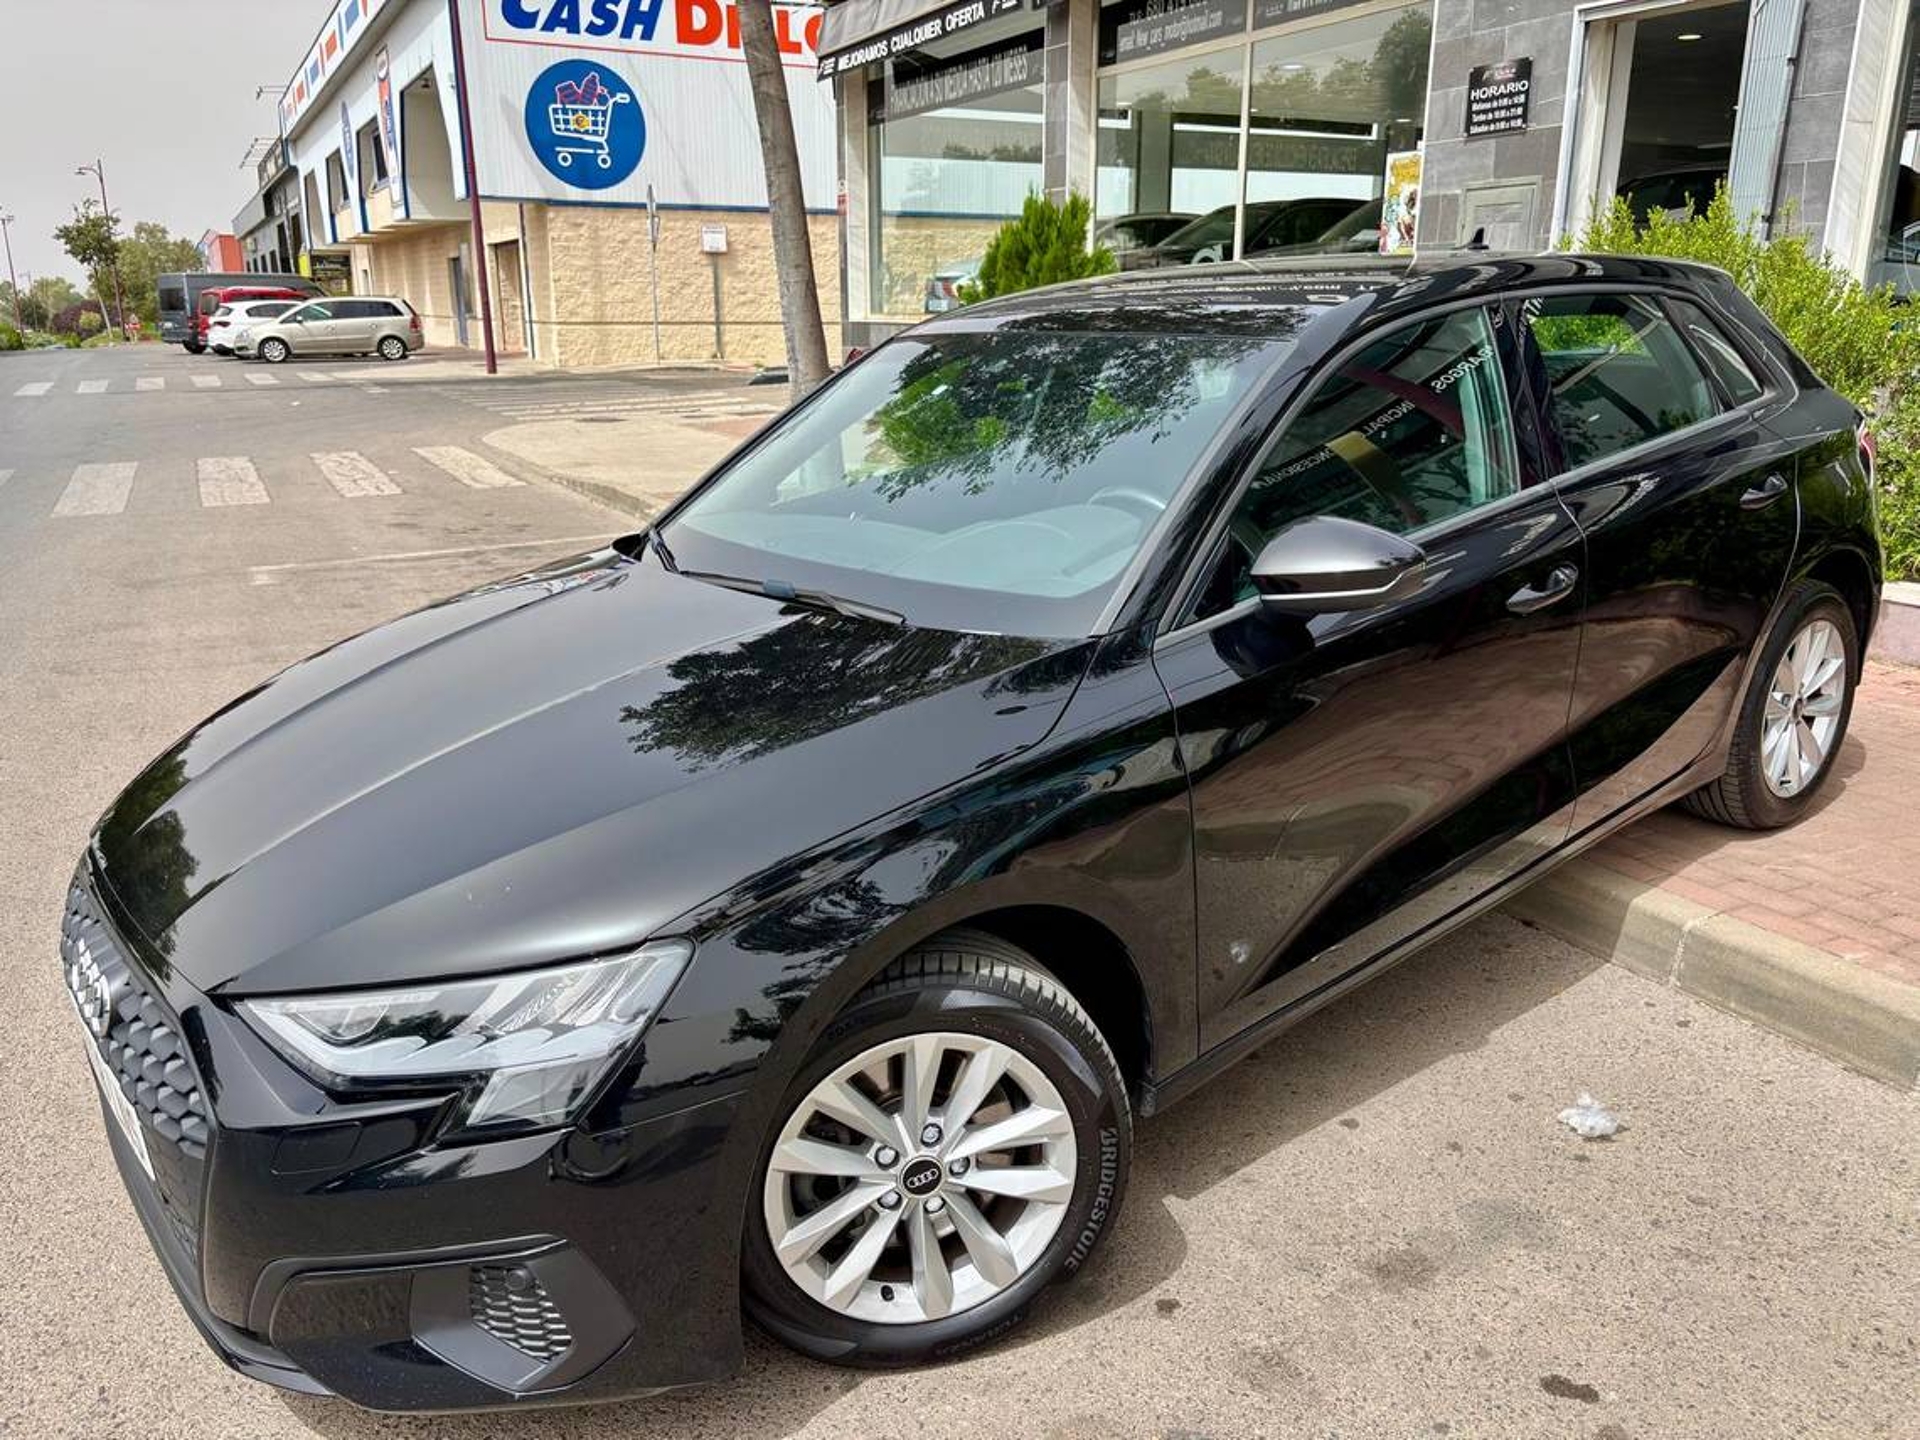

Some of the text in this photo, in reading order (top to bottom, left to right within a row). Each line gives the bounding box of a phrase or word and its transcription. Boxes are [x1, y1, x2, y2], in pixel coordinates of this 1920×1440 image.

[501, 0, 663, 41] CASH
[838, 2, 984, 71] MEJORAMOS CUALQUIER OFERTA
[1471, 80, 1528, 101] HORARIO
[1064, 1127, 1119, 1273] BRIDGESTONE
